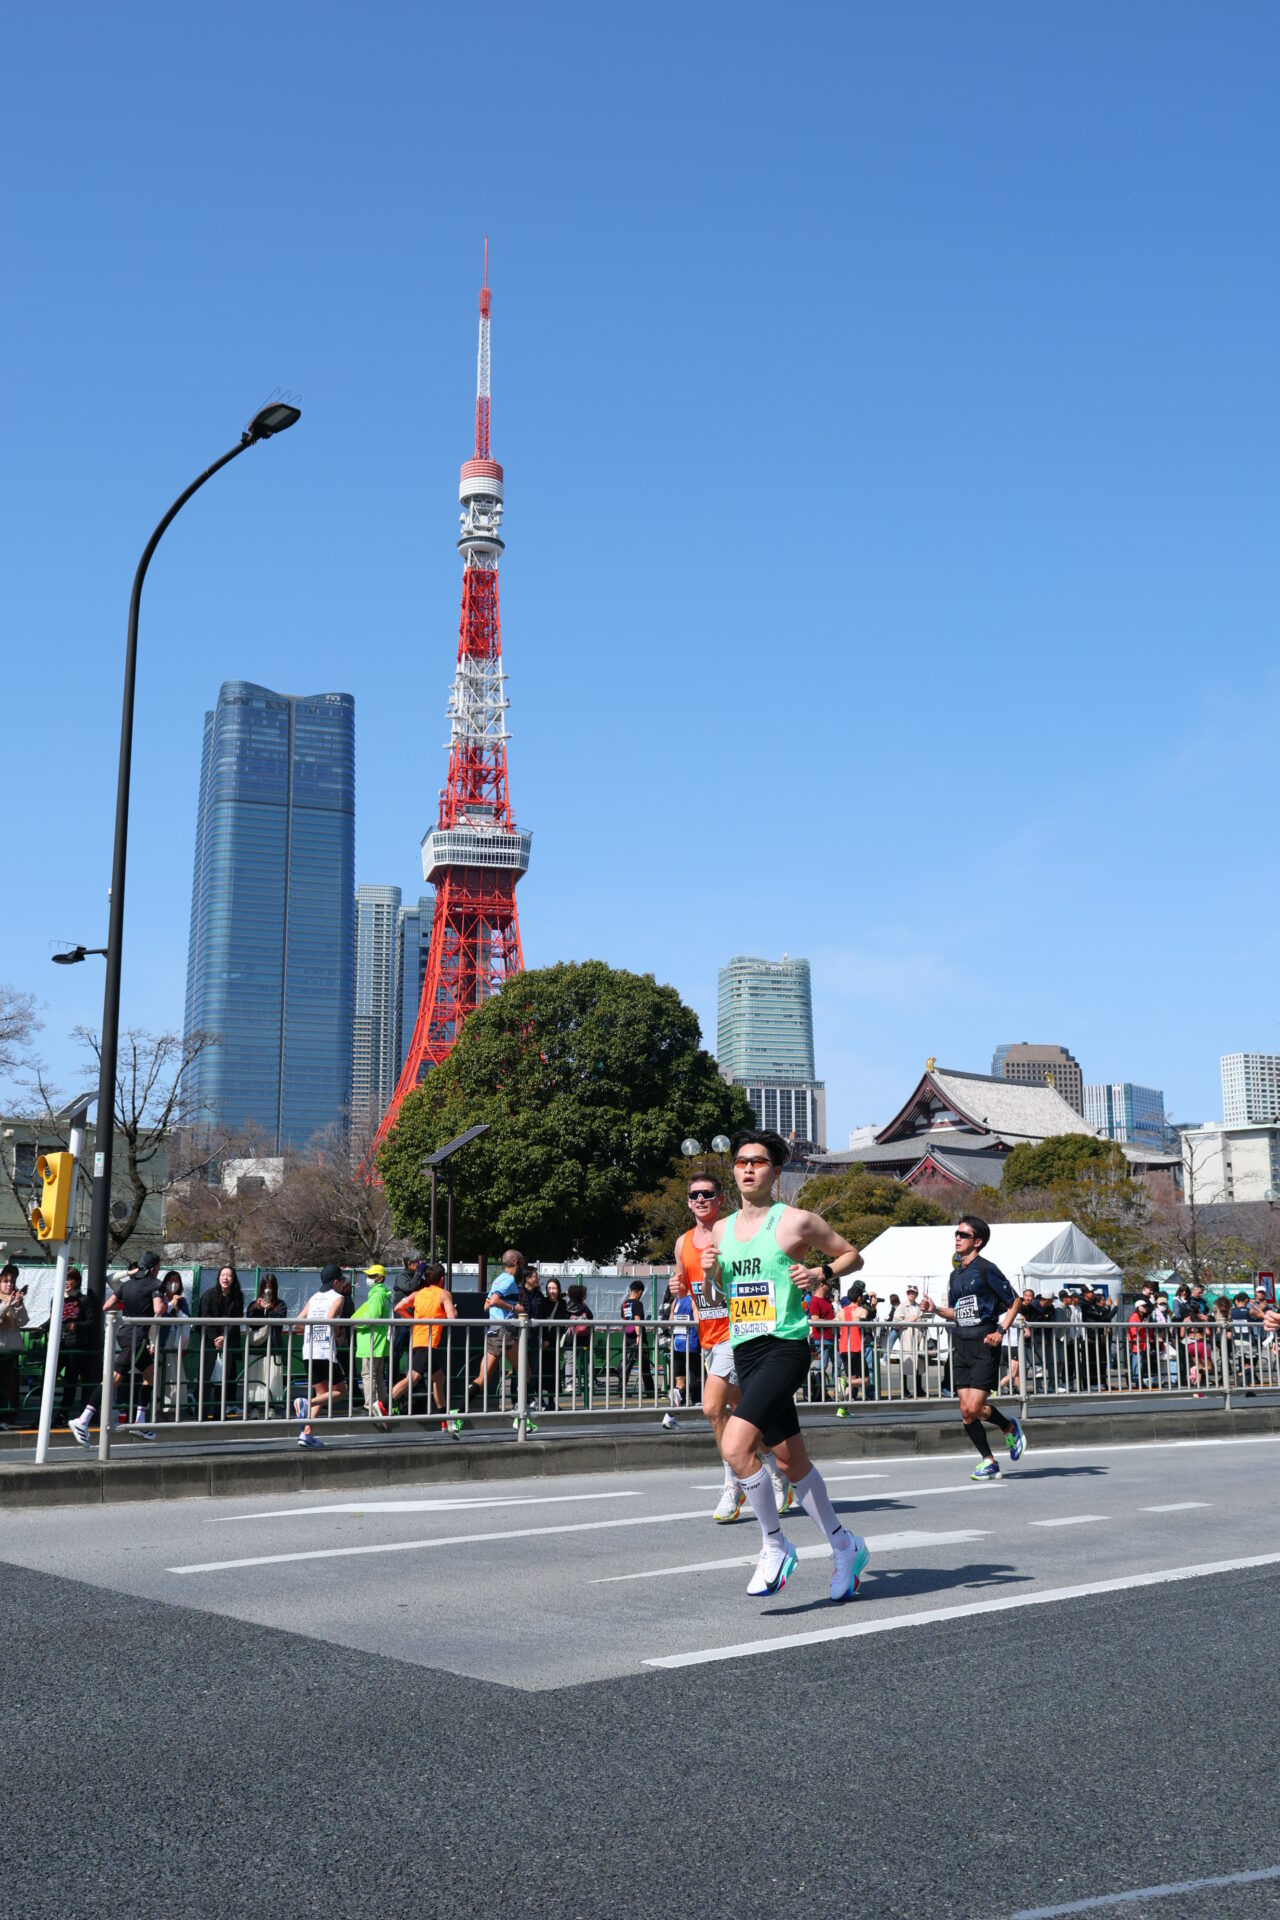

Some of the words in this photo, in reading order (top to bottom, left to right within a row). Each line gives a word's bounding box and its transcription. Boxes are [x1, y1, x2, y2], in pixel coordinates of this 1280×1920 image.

[732, 1257, 761, 1278] NRR
[735, 1299, 767, 1317] 24427
[957, 1306, 975, 1319] 10552
[740, 1322, 769, 1334] STARTS
